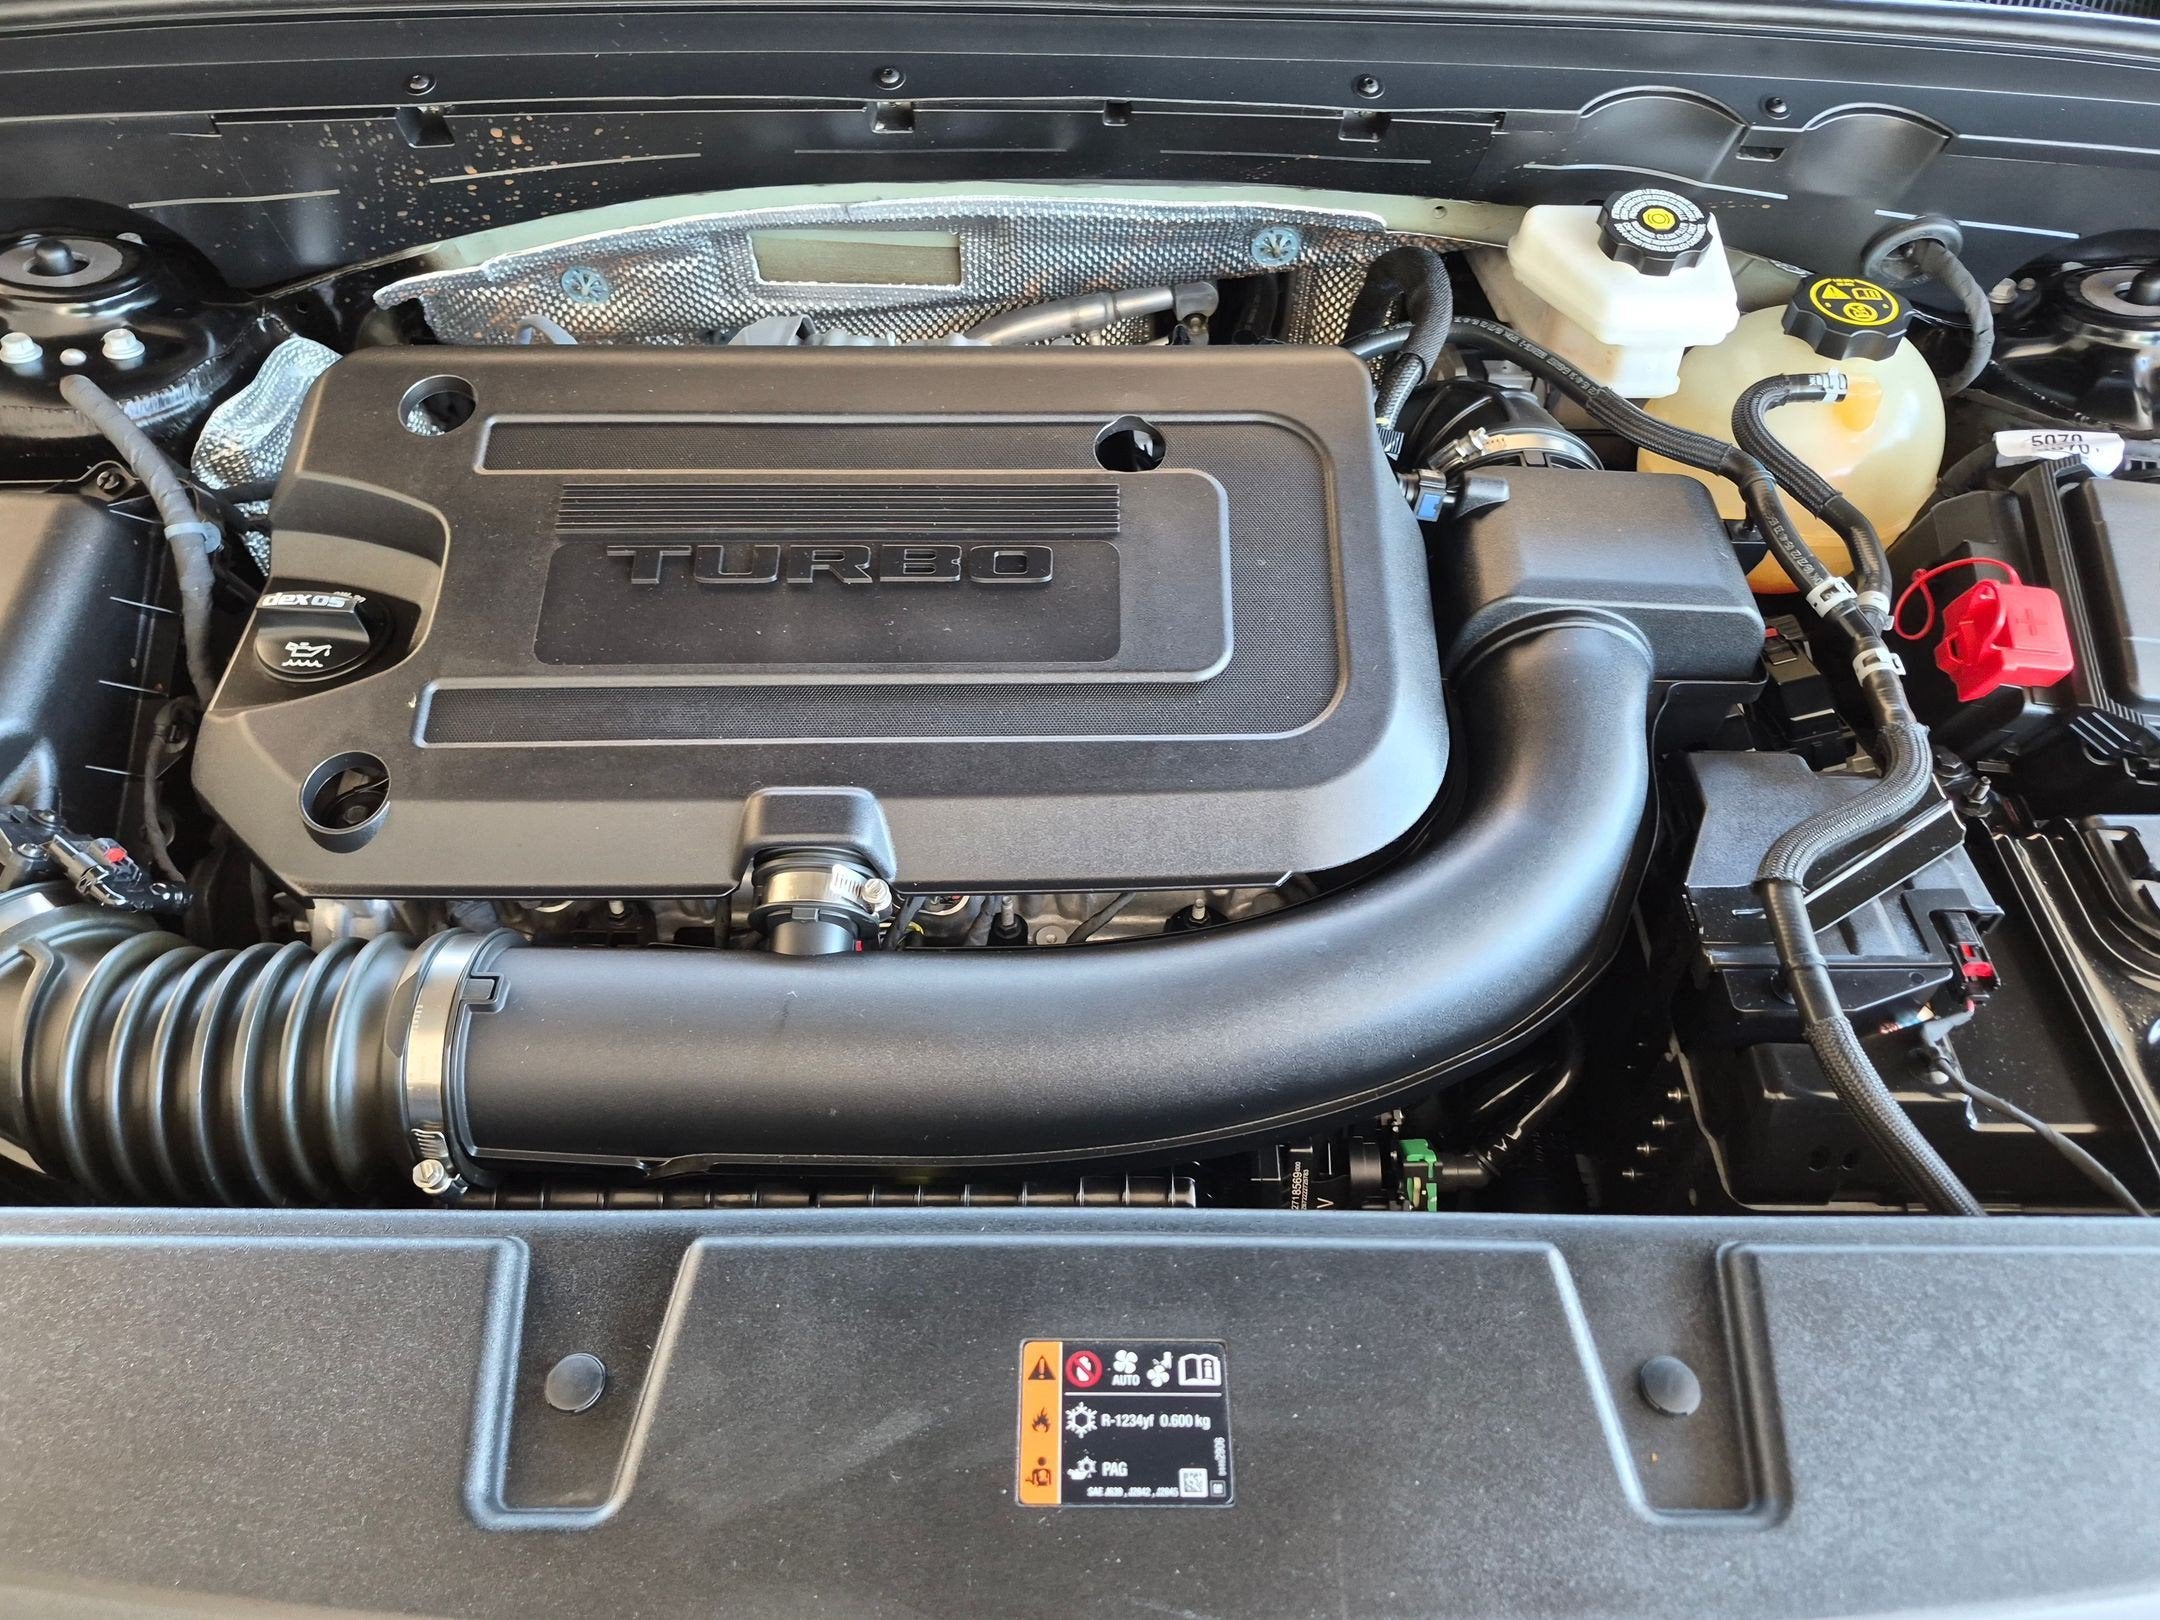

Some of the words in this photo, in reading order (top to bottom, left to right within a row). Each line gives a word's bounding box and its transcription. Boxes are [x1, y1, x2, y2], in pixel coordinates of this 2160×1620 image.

[607, 544, 1054, 584] TURBO
[1112, 1374, 1140, 1386] AUTO
[1101, 1413, 1155, 1430] R-1234yf
[1159, 1413, 1193, 1428] 0.600
[1195, 1413, 1211, 1430] kg
[1102, 1462, 1128, 1477] PAG
[1087, 1486, 1104, 1497] SAE
